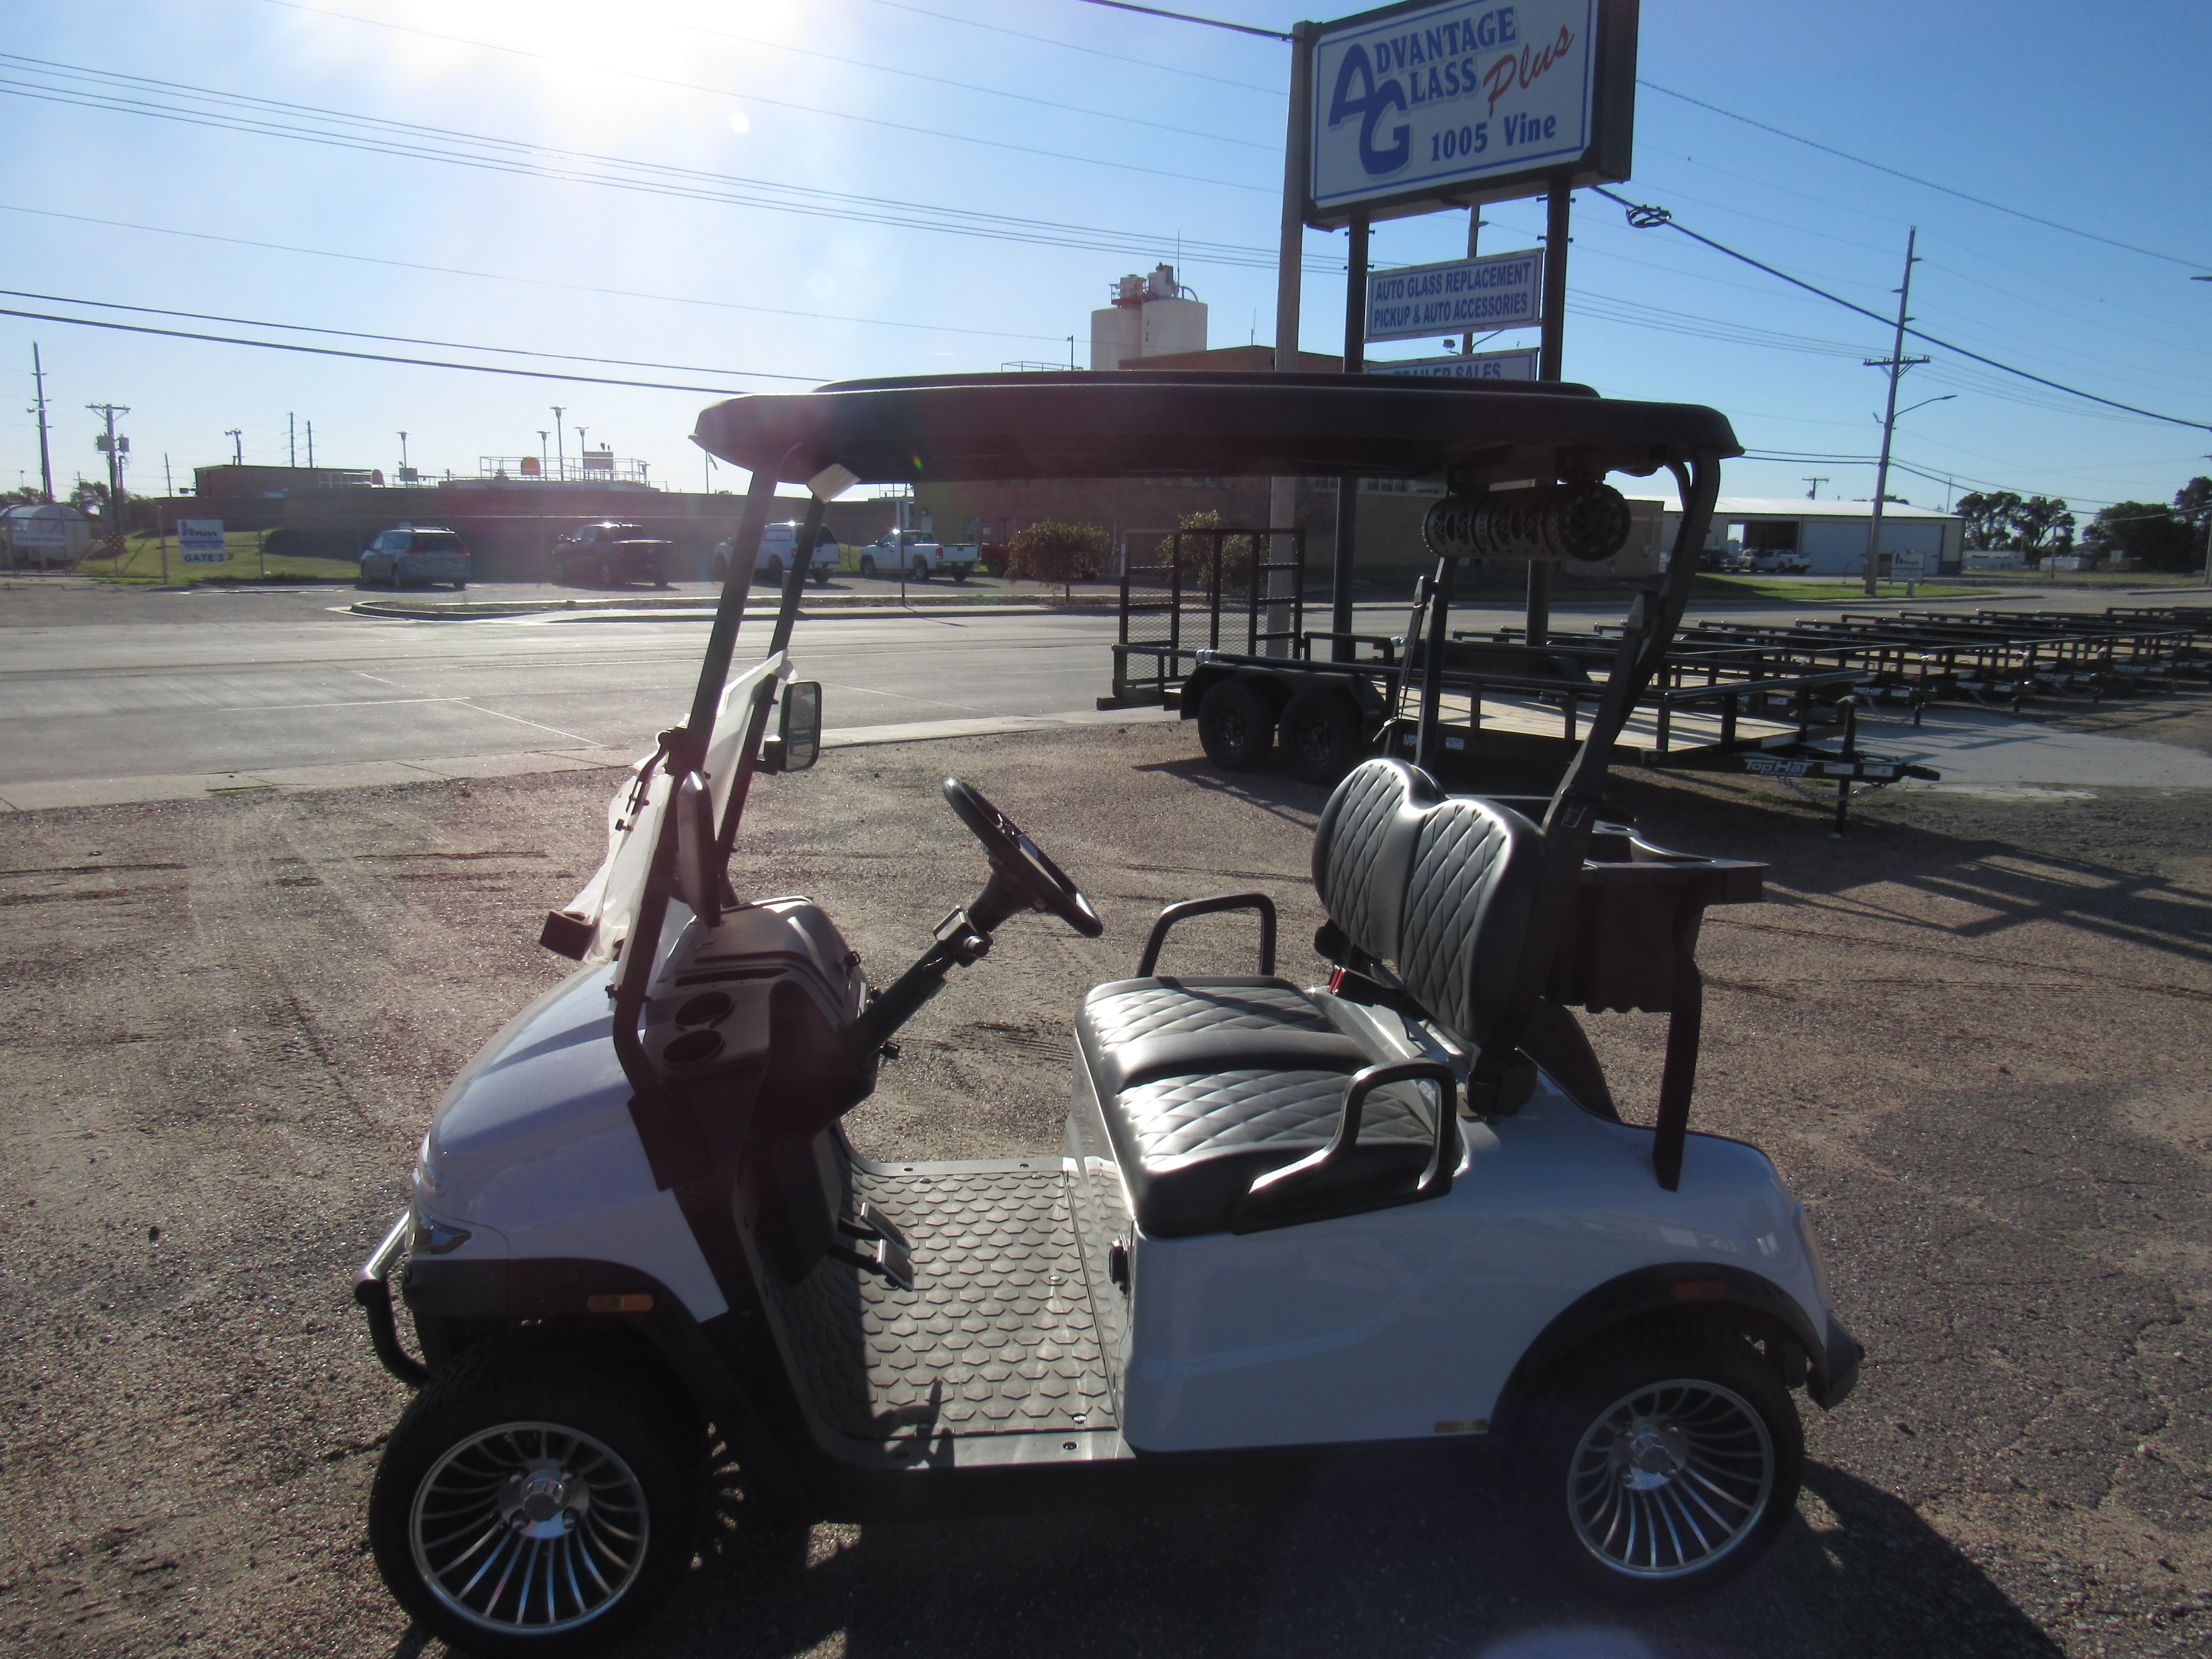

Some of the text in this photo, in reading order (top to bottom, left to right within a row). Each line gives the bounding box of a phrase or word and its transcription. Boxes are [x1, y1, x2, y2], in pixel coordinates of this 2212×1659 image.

[1483, 25, 1575, 118] Plus
[1431, 111, 1556, 162] 1005 Vine
[1375, 262, 1531, 301] AUTO GLASS REPLACEMENT
[1374, 292, 1527, 328] PICKUP & AUTO ACCESSORIES
[1403, 734, 1419, 746] MP
